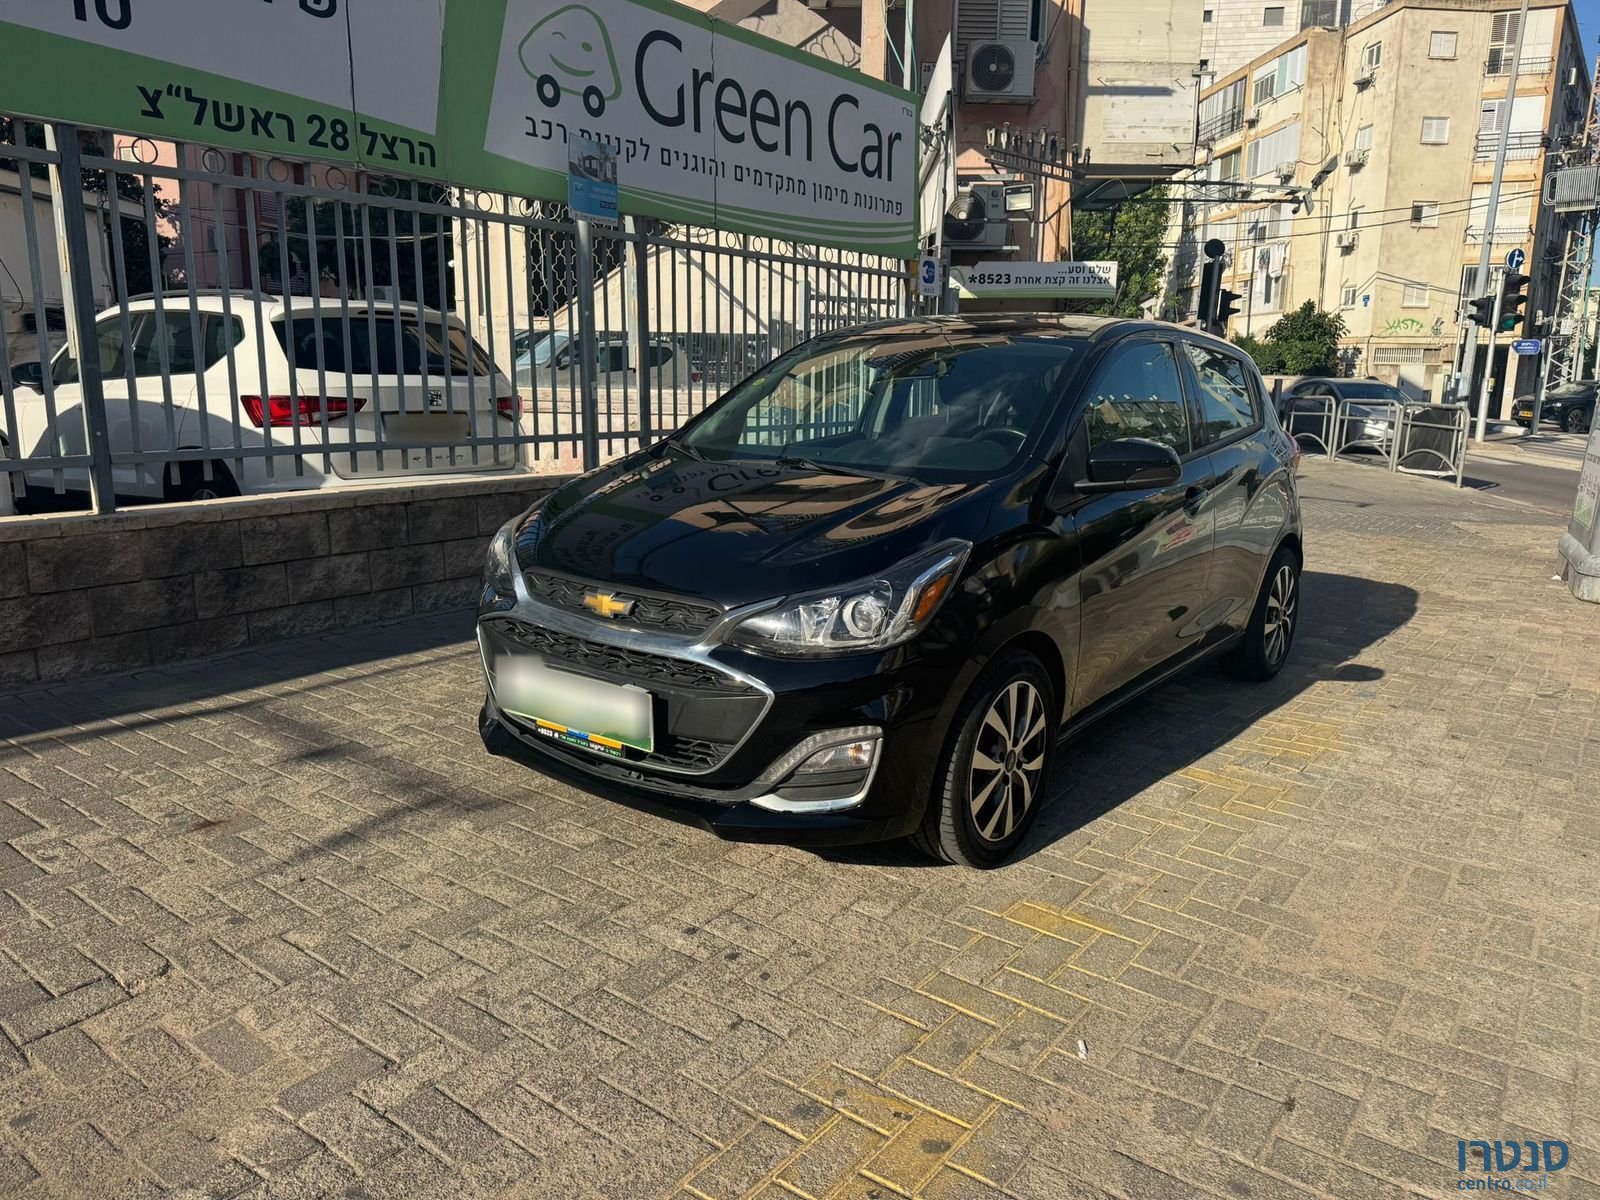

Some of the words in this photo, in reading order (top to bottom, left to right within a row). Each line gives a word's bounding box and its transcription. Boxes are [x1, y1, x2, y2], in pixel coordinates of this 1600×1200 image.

[635, 30, 812, 162] Green
[828, 93, 902, 182] Car
[307, 114, 349, 151] 28
[525, 115, 567, 144] רכב
[359, 122, 436, 168] הרצל
[661, 147, 725, 178] והוגנים
[735, 164, 806, 195] מתקדמים
[813, 182, 848, 204] מימון
[854, 192, 903, 216] פתרונות
[1014, 276, 1042, 285] אחרת
[1044, 276, 1066, 286] קצת
[1069, 276, 1080, 284] זה
[1083, 274, 1111, 285] אצלנו
[1088, 264, 1111, 274] שלם
